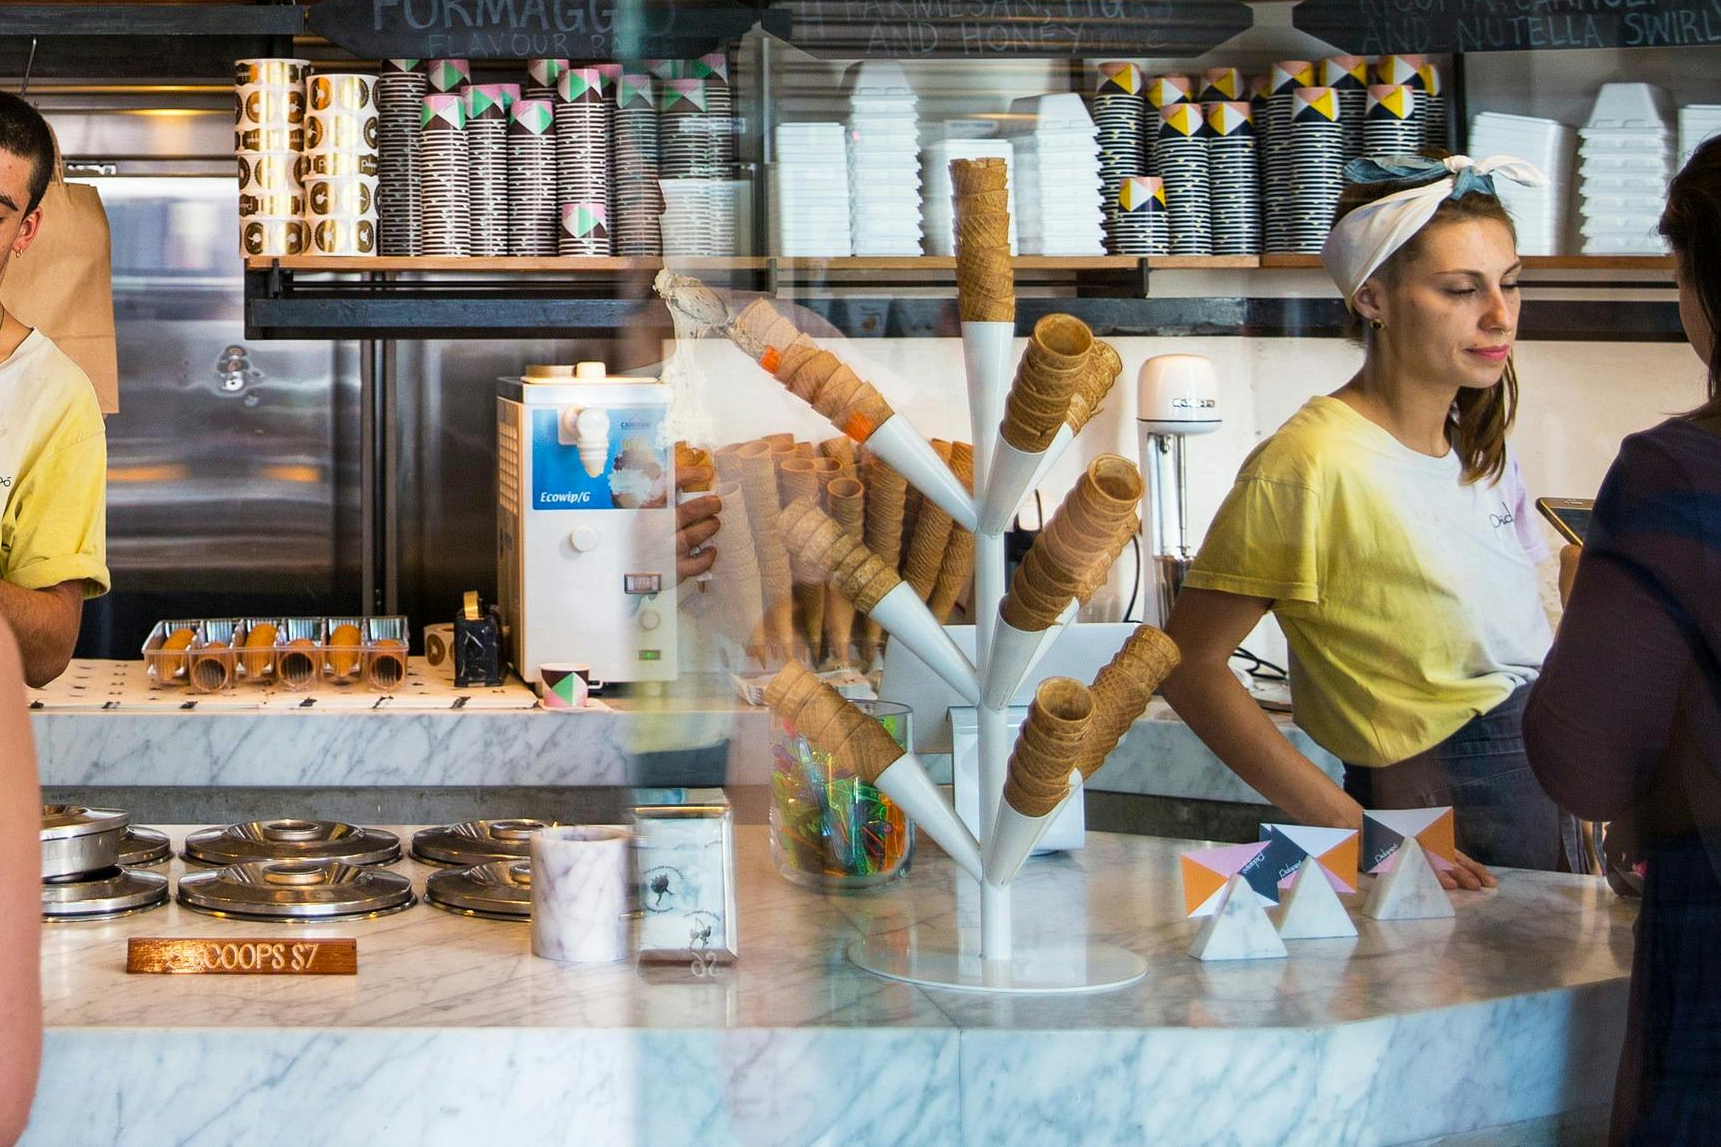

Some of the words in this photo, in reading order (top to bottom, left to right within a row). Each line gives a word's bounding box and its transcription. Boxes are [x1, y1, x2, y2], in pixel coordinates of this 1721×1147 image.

[428, 33, 569, 57] FLAVOUR
[866, 24, 939, 56] AND
[962, 24, 1085, 56] HONEY
[1361, 18, 1431, 53] AND
[1454, 15, 1602, 51] NUTELLA
[540, 491, 591, 503] Ecowip/G
